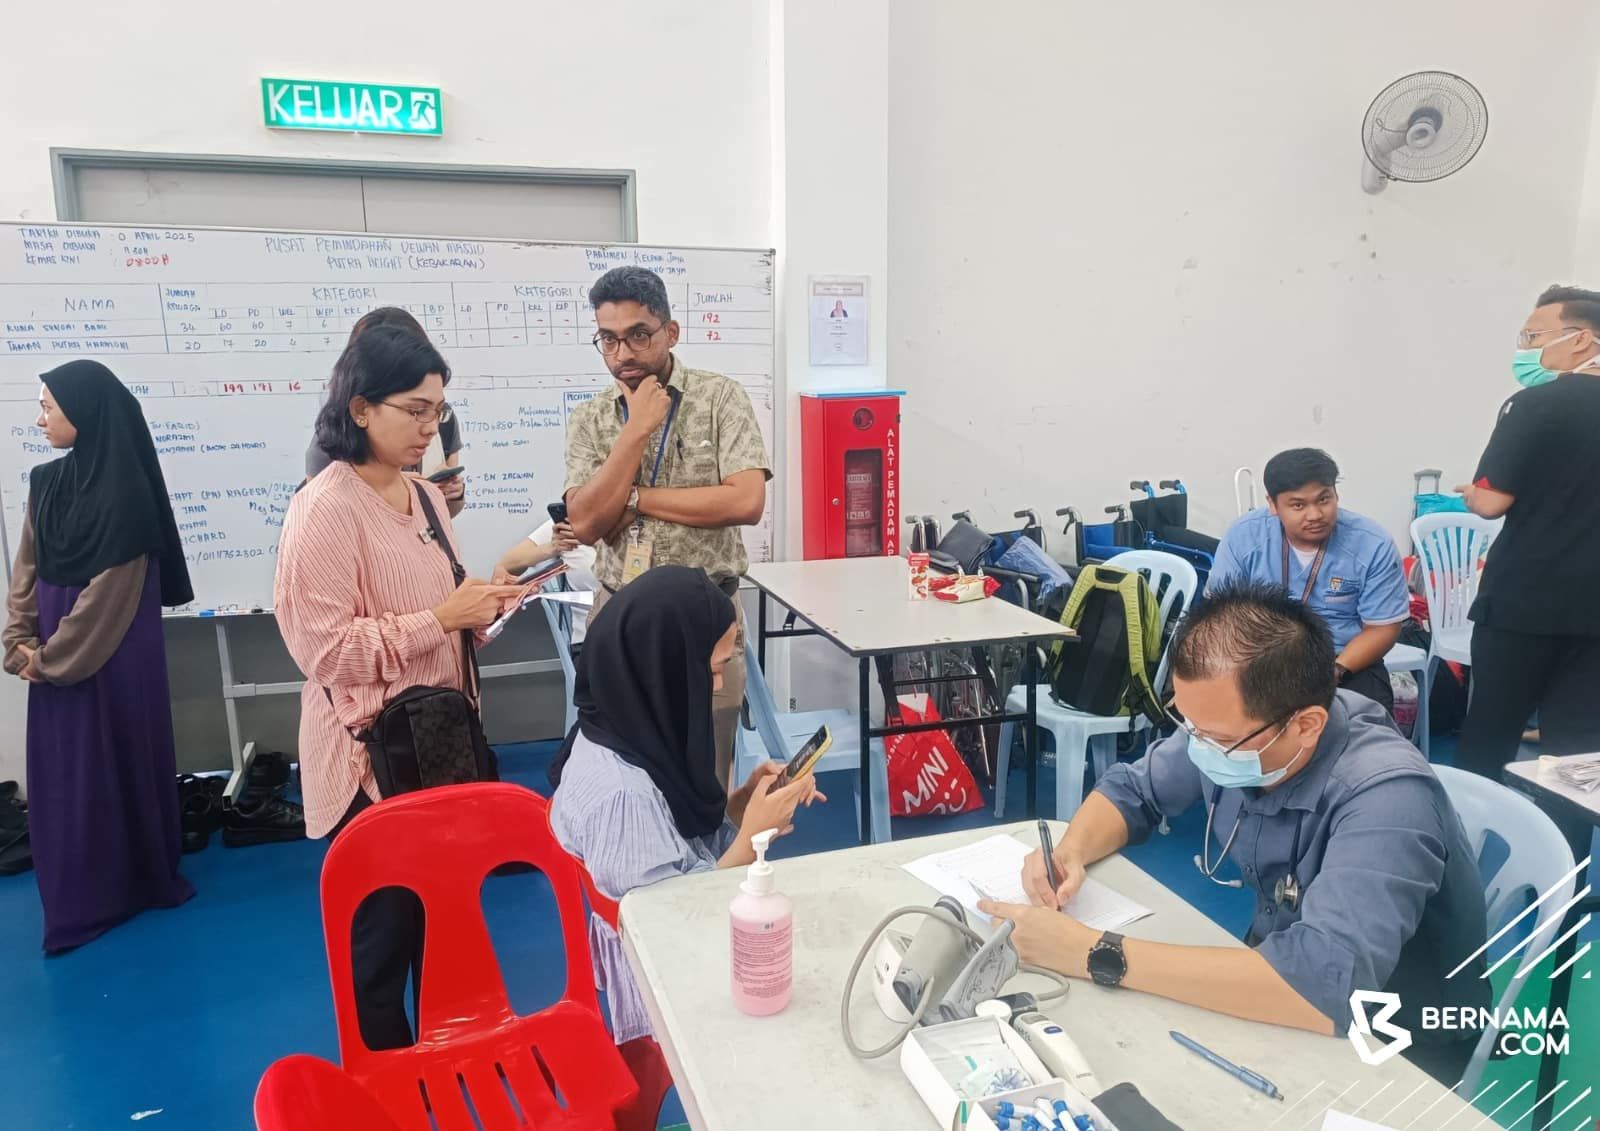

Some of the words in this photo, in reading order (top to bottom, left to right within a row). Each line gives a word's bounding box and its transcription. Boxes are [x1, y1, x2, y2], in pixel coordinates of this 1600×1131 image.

[267, 82, 404, 128] KELUAR
[165, 232, 195, 242] 2025
[24, 240, 54, 250] MASA
[264, 237, 305, 253] PUSAT
[327, 255, 362, 269] PUTRA
[311, 287, 377, 302] KATEGORI
[513, 285, 573, 297] KATEGORI
[64, 297, 115, 313] NAMA
[702, 312, 721, 324] 192
[887, 428, 895, 466] ALAT
[887, 470, 895, 536] PEMADAM
[903, 745, 949, 815] MINI
